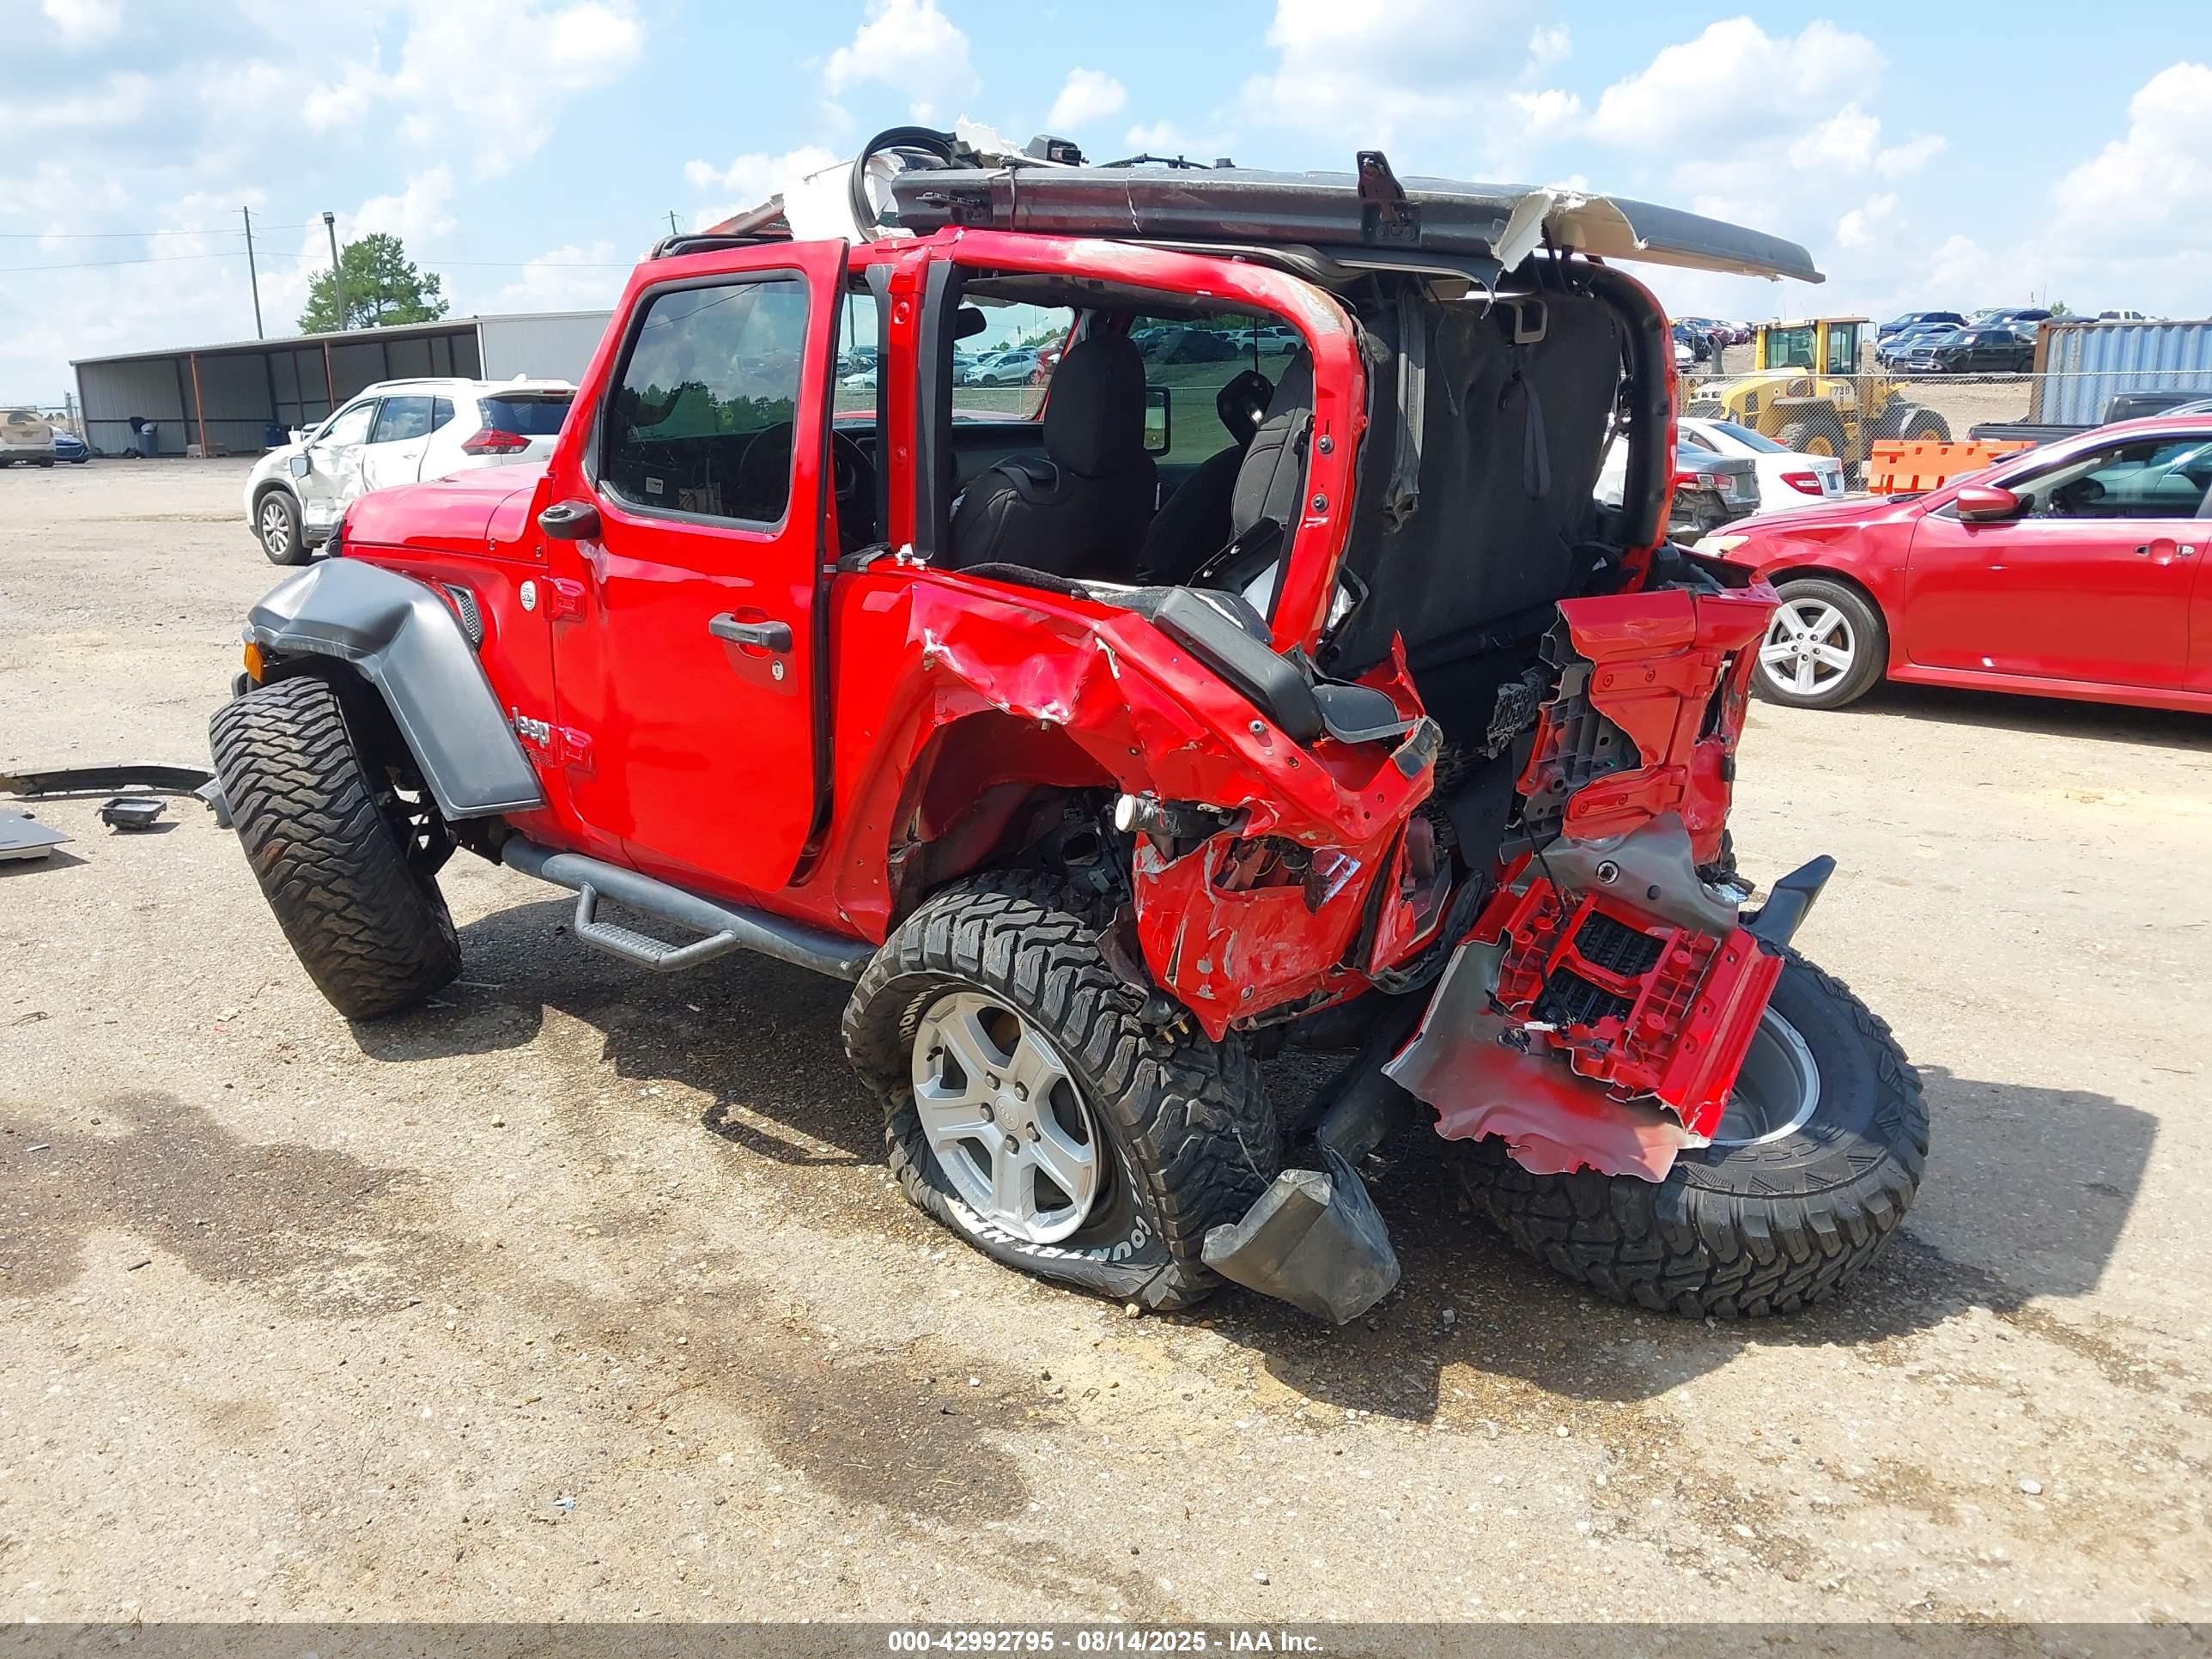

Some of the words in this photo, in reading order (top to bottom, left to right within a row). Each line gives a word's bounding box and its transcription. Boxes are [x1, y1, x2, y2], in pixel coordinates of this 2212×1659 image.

[508, 706, 550, 750] Jeep
[898, 981, 969, 1043] IRONMAN
[1014, 1215, 1152, 1262] COUNTRY
